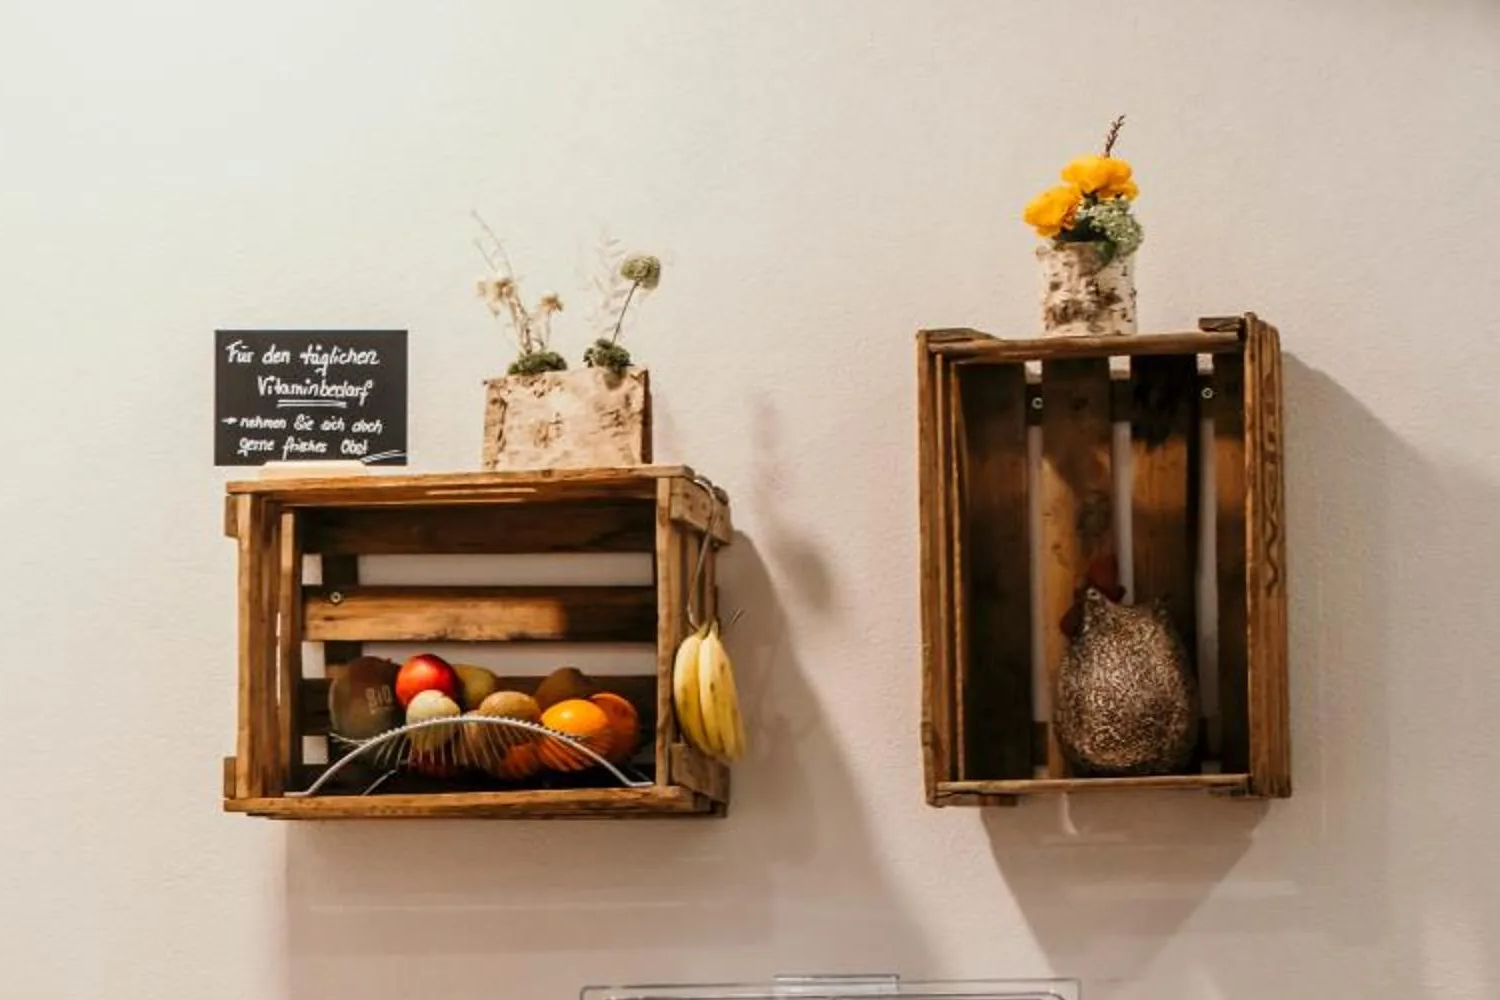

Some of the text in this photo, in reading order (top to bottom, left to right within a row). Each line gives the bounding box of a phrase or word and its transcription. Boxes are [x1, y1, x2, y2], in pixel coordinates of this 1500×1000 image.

[226, 340, 380, 376] Für den täglichen
[257, 375, 373, 406] Vitaminbedarf
[239, 413, 382, 434] nehmen Sie sich doch
[237, 437, 275, 457] gerne
